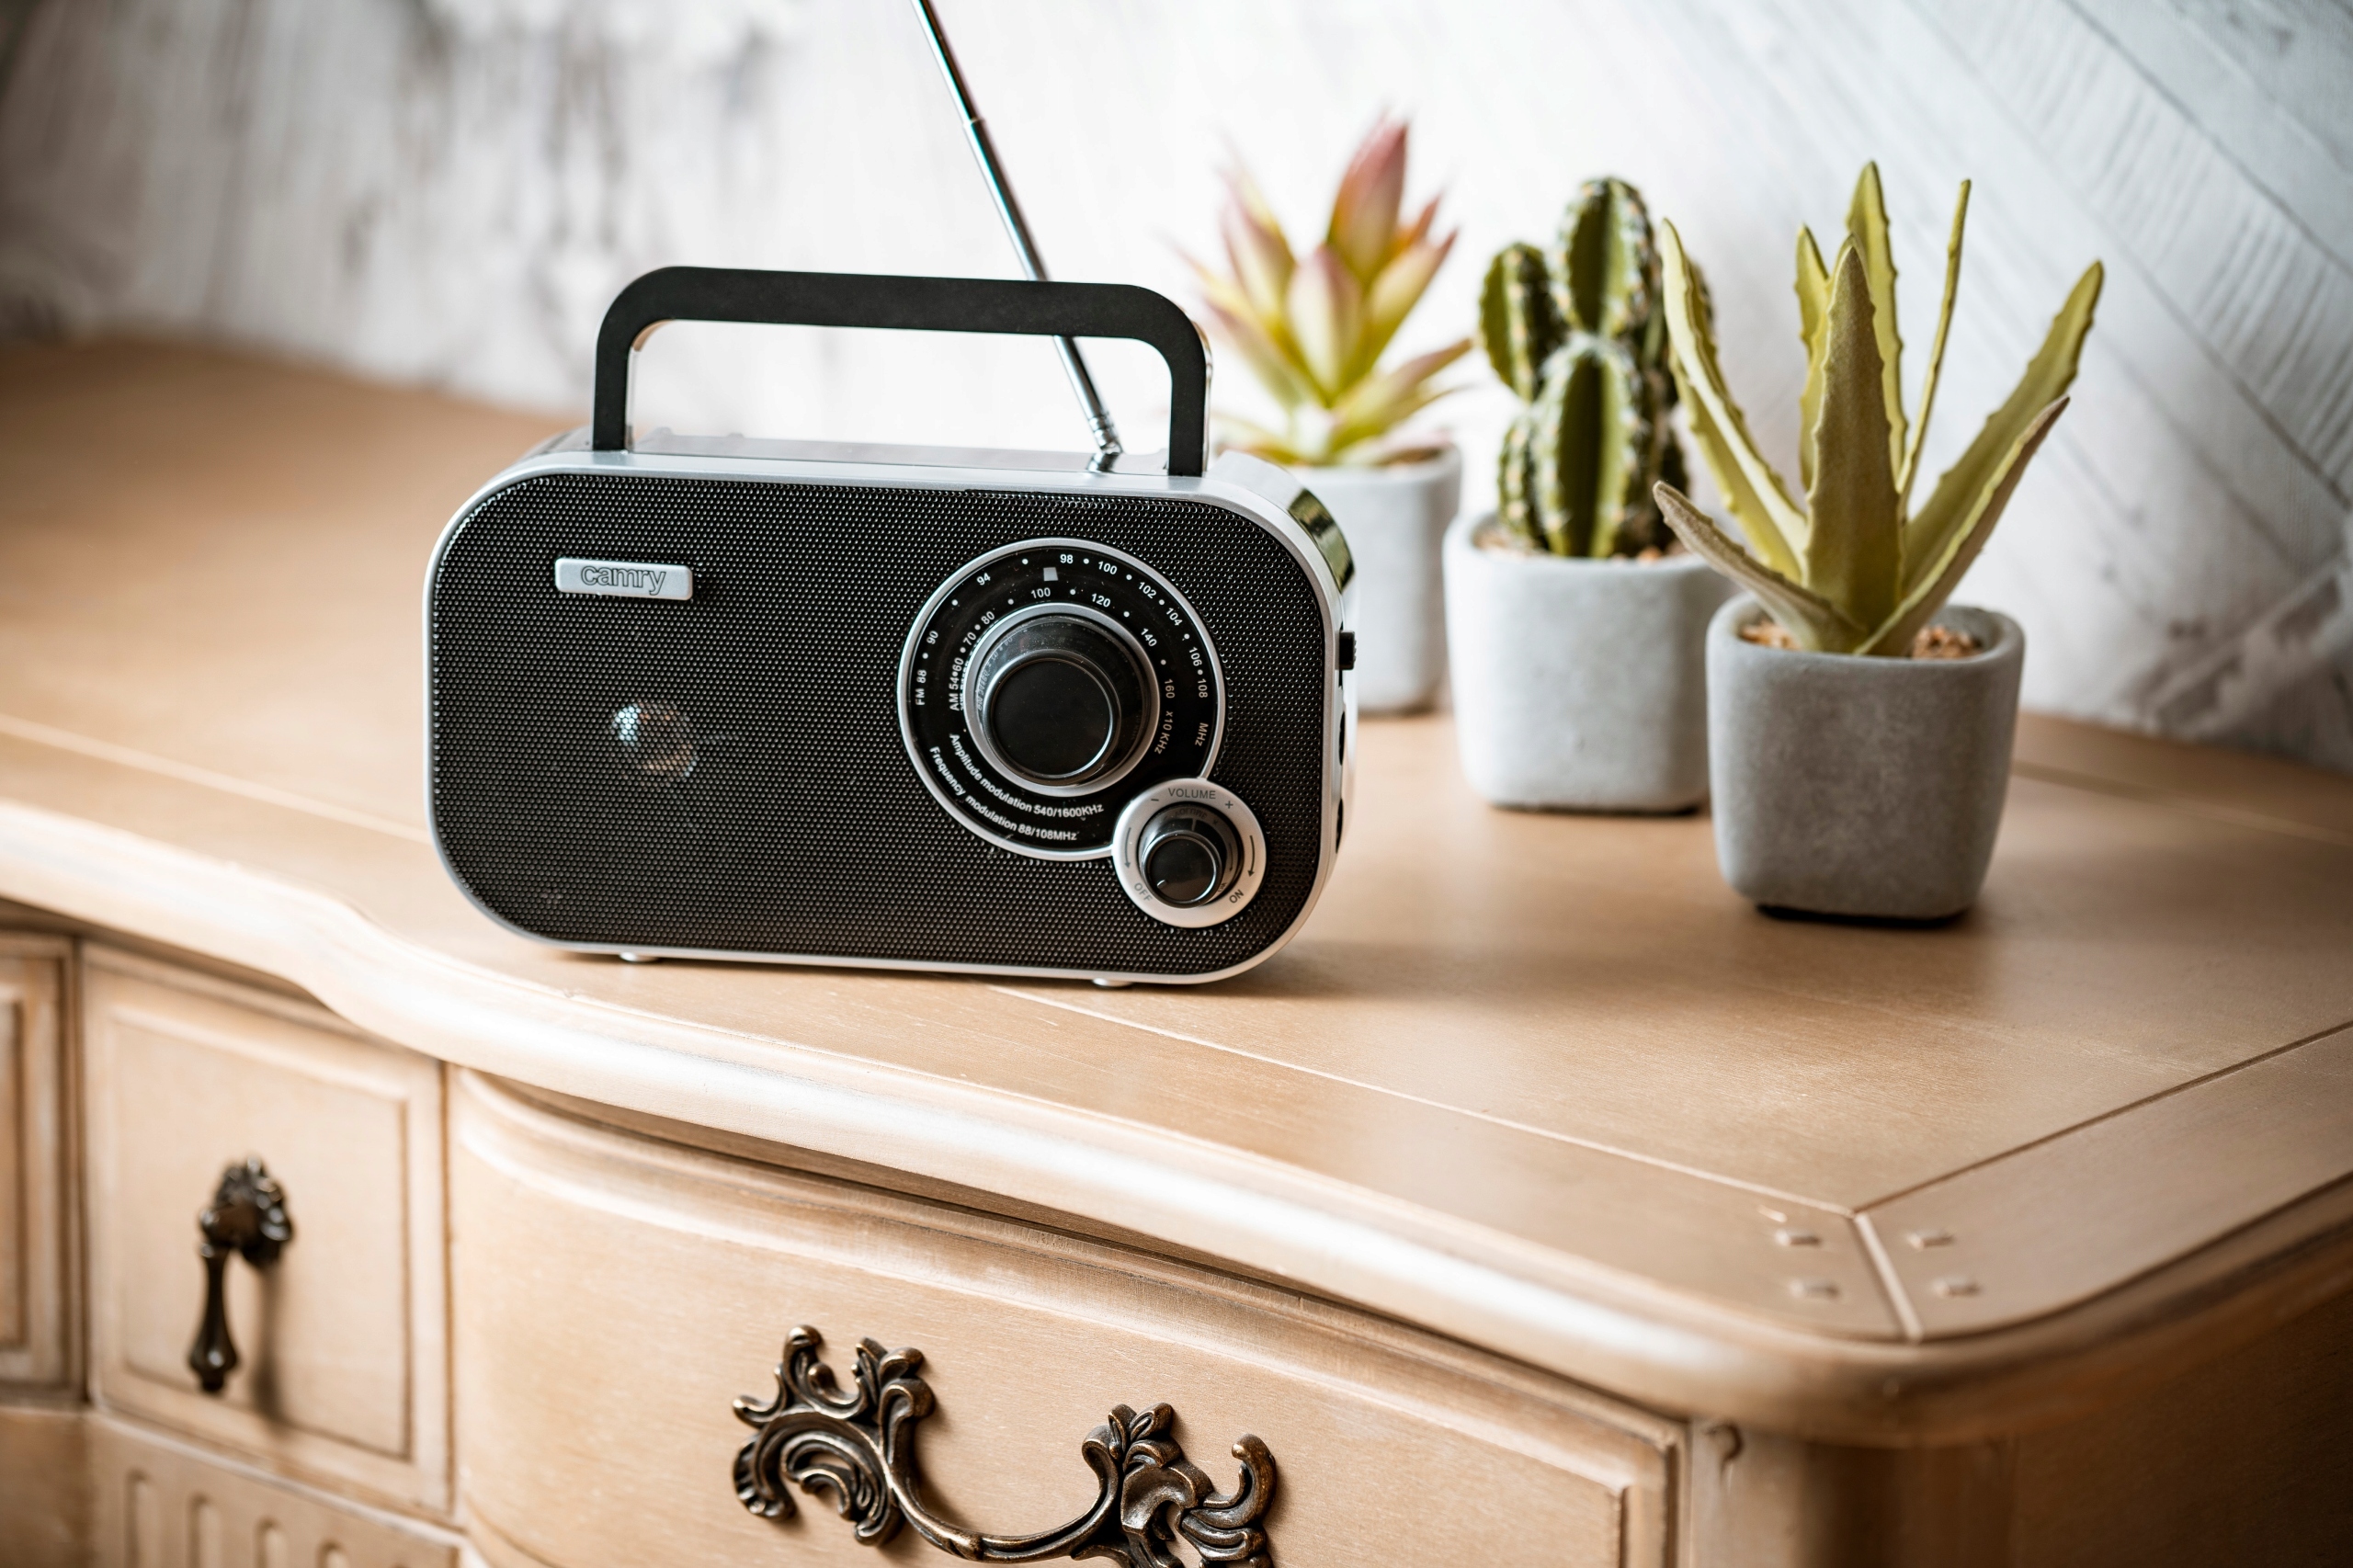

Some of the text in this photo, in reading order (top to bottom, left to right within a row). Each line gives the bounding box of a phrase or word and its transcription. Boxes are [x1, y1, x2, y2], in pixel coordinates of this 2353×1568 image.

[581, 565, 666, 596] camry
[1030, 587, 1051, 599] 100
[1091, 593, 1111, 608] 120
[981, 610, 995, 625] 80
[962, 631, 977, 646] 70
[1141, 628, 1157, 647] 140
[915, 553, 1209, 746] FM 88 90 94 98 100 102 104 106 108 MHz
[952, 657, 964, 672] 60
[949, 676, 960, 690] 54
[1164, 678, 1176, 699] 160
[949, 693, 961, 711] AM
[949, 733, 1104, 819] Amplitude modulation 540/1600KHz
[929, 746, 1077, 841] Frequency modulation 88/108MHz
[1167, 788, 1216, 800] VOLUME
[1133, 882, 1153, 903] OFF
[1229, 889, 1245, 903] ON
